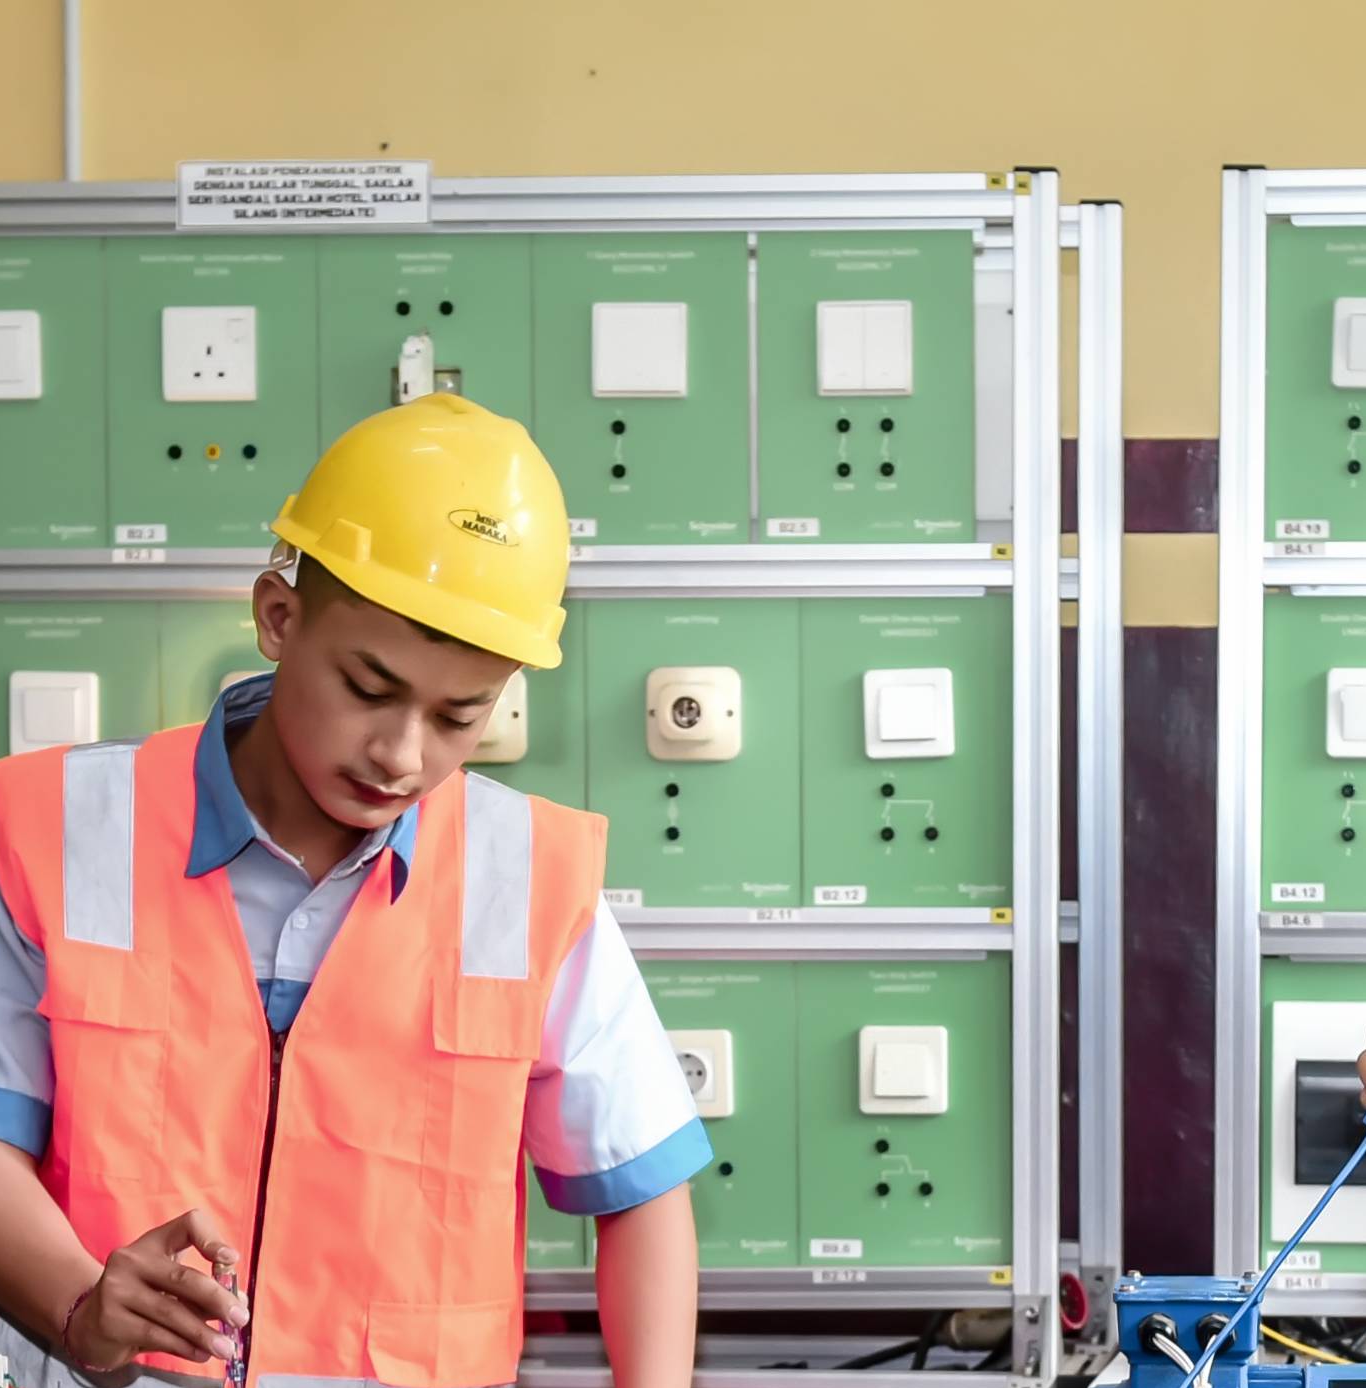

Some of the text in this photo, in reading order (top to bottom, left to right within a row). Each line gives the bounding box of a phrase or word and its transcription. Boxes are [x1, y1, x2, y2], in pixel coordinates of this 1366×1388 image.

[194, 180, 244, 190] DENGAN
[248, 179, 297, 190] SAKLAR
[364, 178, 413, 188] SAKLAR
[275, 194, 323, 204] SAKLAR
[372, 192, 421, 203] SAKLAR
[233, 208, 277, 219] SILANG
[1280, 887, 1317, 898] B4.12
